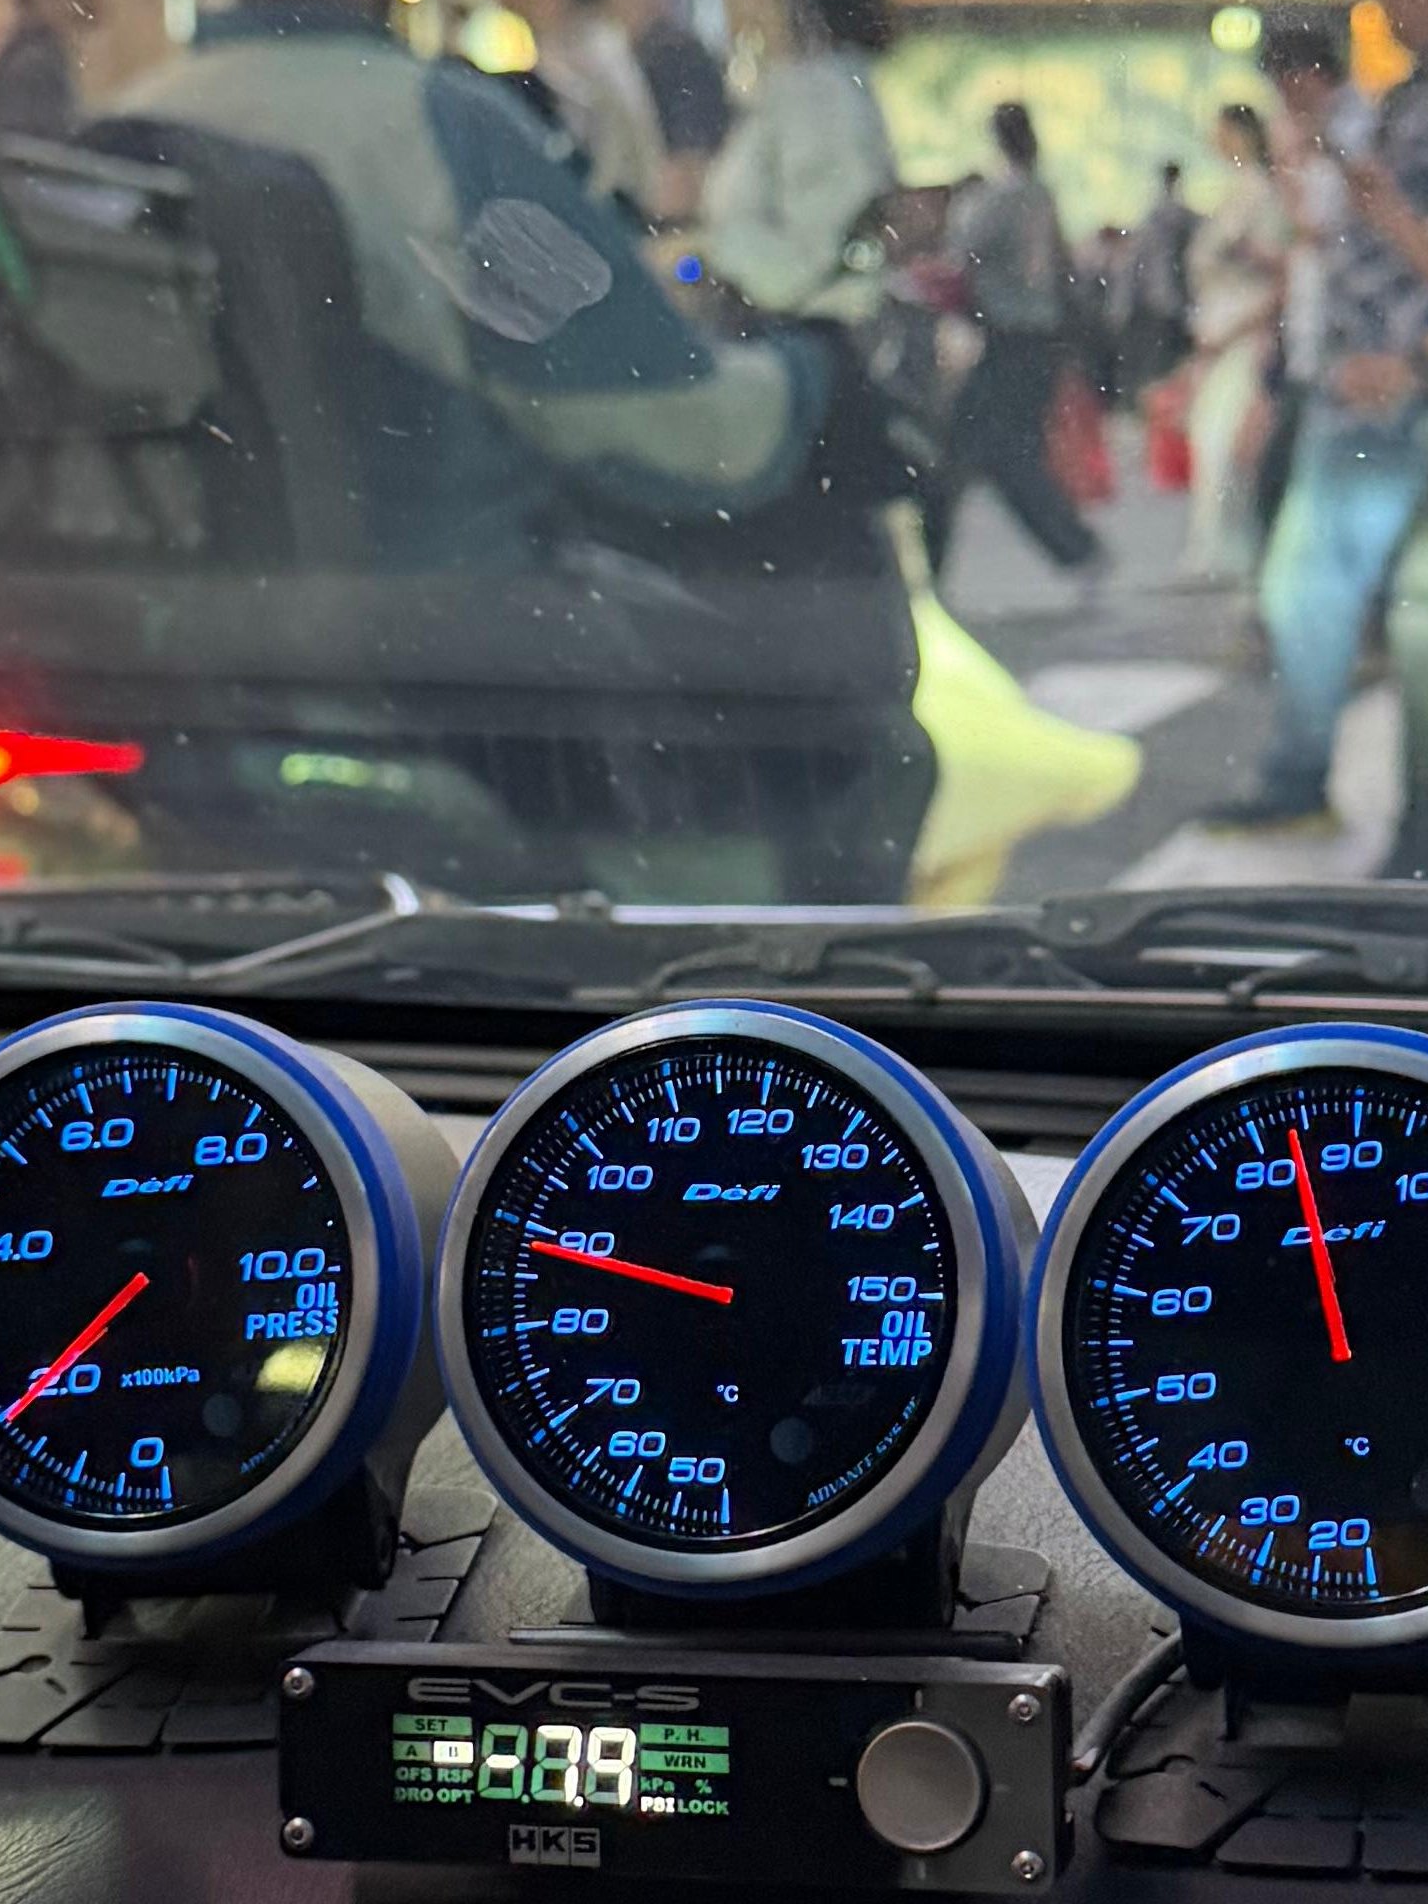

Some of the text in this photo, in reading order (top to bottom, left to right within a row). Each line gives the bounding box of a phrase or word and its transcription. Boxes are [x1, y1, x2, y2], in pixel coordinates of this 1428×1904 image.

[60, 1118, 135, 1153] 6.0
[647, 1117, 701, 1144] 110
[727, 1108, 794, 1135] 120
[194, 1132, 268, 1166] 8.0
[800, 1143, 869, 1171] 130
[1320, 1140, 1383, 1172] 90
[586, 1164, 654, 1191] 100
[1235, 1158, 1296, 1191] 80
[828, 1203, 894, 1231] 140
[1180, 1212, 1240, 1245] 70
[559, 1231, 616, 1259] 90
[238, 1247, 326, 1281] 10.0
[296, 1281, 339, 1311] OIL
[847, 1276, 917, 1304] 150
[1151, 1285, 1213, 1317] 60
[245, 1308, 339, 1340] PRESS
[551, 1308, 609, 1335] 80
[881, 1310, 931, 1339] OIL
[841, 1339, 933, 1367] TEMP
[27, 1363, 101, 1396] 2.0
[120, 1365, 201, 1390] x100kPa
[584, 1377, 641, 1405] 70
[1155, 1372, 1217, 1403] 50
[129, 1435, 165, 1469] 0
[608, 1431, 667, 1459] 60
[1187, 1440, 1248, 1471] 40
[668, 1457, 726, 1485] 50
[1240, 1494, 1301, 1526] 30
[1308, 1518, 1371, 1550] 20
[407, 1677, 701, 1712] EVC-S
[415, 1718, 449, 1732] SET
[405, 1745, 418, 1757] A
[664, 1754, 706, 1770] WRN
[436, 1789, 473, 1805] OPT
[640, 1776, 675, 1793] kPa
[640, 1796, 730, 1815] PSI LOCK
[511, 1826, 599, 1857] HKS
